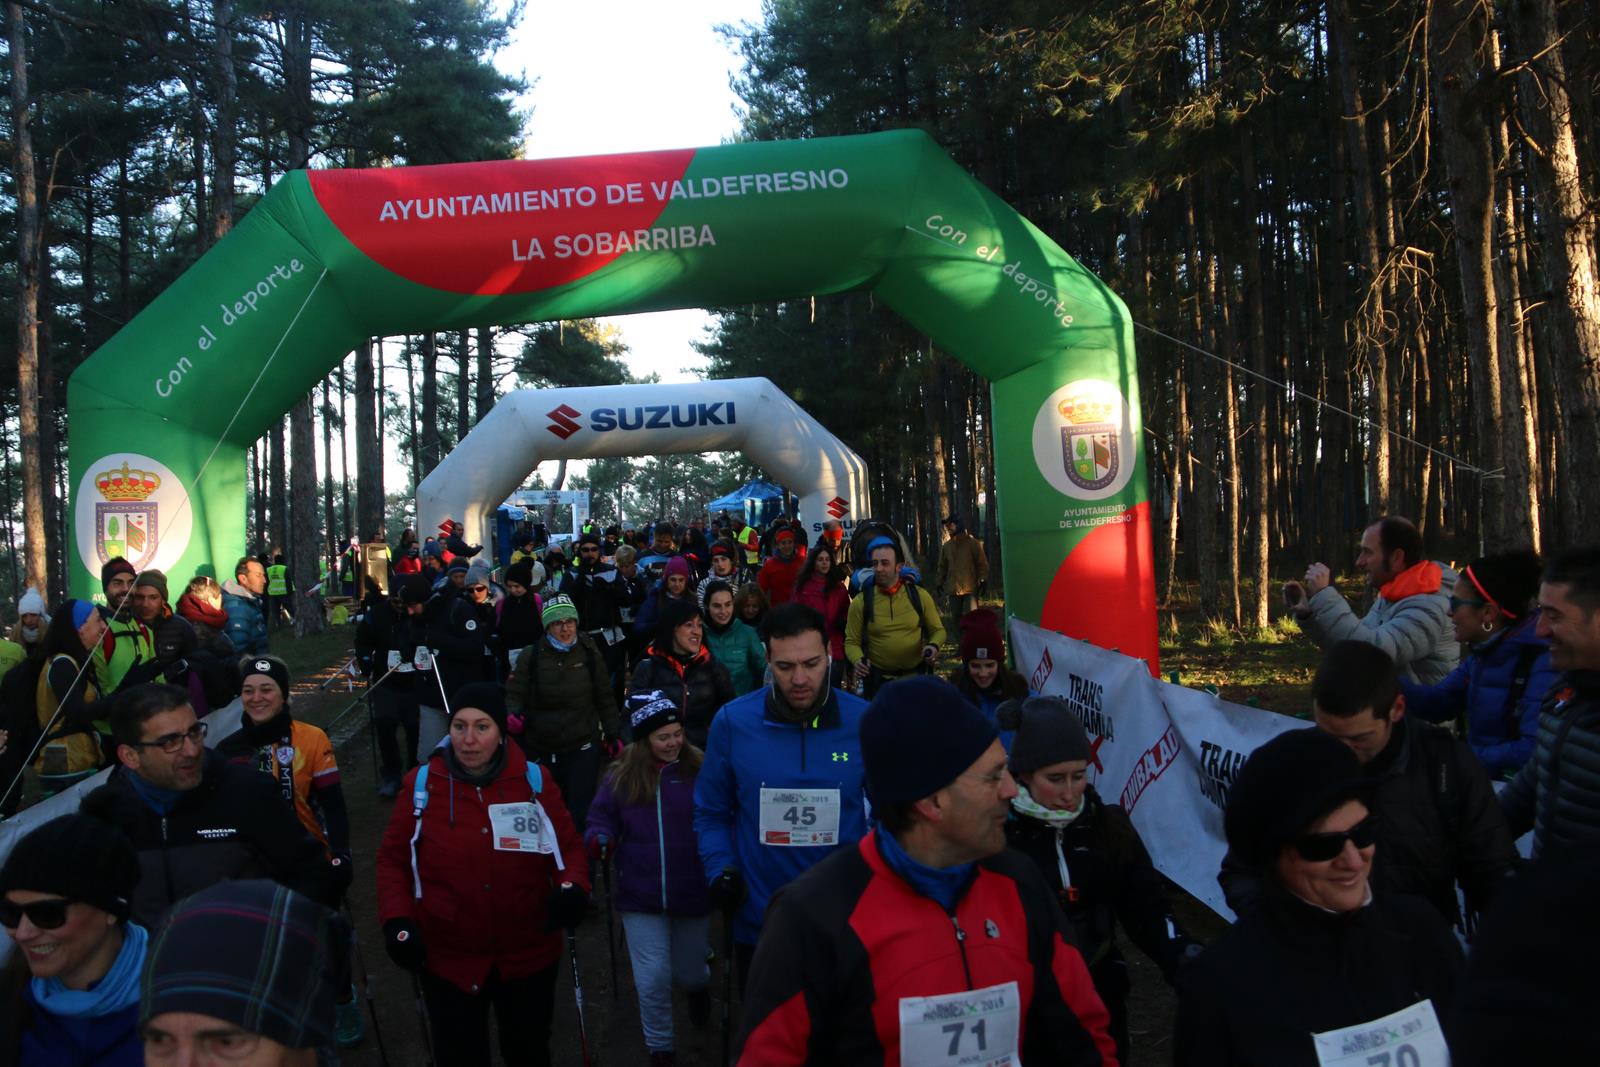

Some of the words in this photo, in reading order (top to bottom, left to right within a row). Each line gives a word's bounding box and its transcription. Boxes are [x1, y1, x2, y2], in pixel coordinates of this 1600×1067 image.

[378, 185, 598, 222] AYUNTAMIENTO
[607, 183, 645, 205] DE
[650, 167, 850, 200] VALDEFRESNO
[511, 236, 546, 262] LA
[553, 224, 717, 259] SOBARRIBA
[925, 214, 968, 246] Con
[976, 244, 1000, 262] el
[1002, 260, 1075, 328] deporte
[155, 356, 193, 398] Con
[197, 324, 217, 350] el
[220, 258, 305, 326] deporte
[590, 401, 736, 432] SUZUKI
[1059, 519, 1073, 529] DE
[1074, 514, 1132, 529] VALDEFRESNO
[1063, 503, 1127, 518] AYUNTAMIENTO
[1068, 672, 1104, 712] TRANS
[513, 816, 539, 834] 86
[783, 806, 817, 826] 45
[942, 1018, 987, 1057] 71
